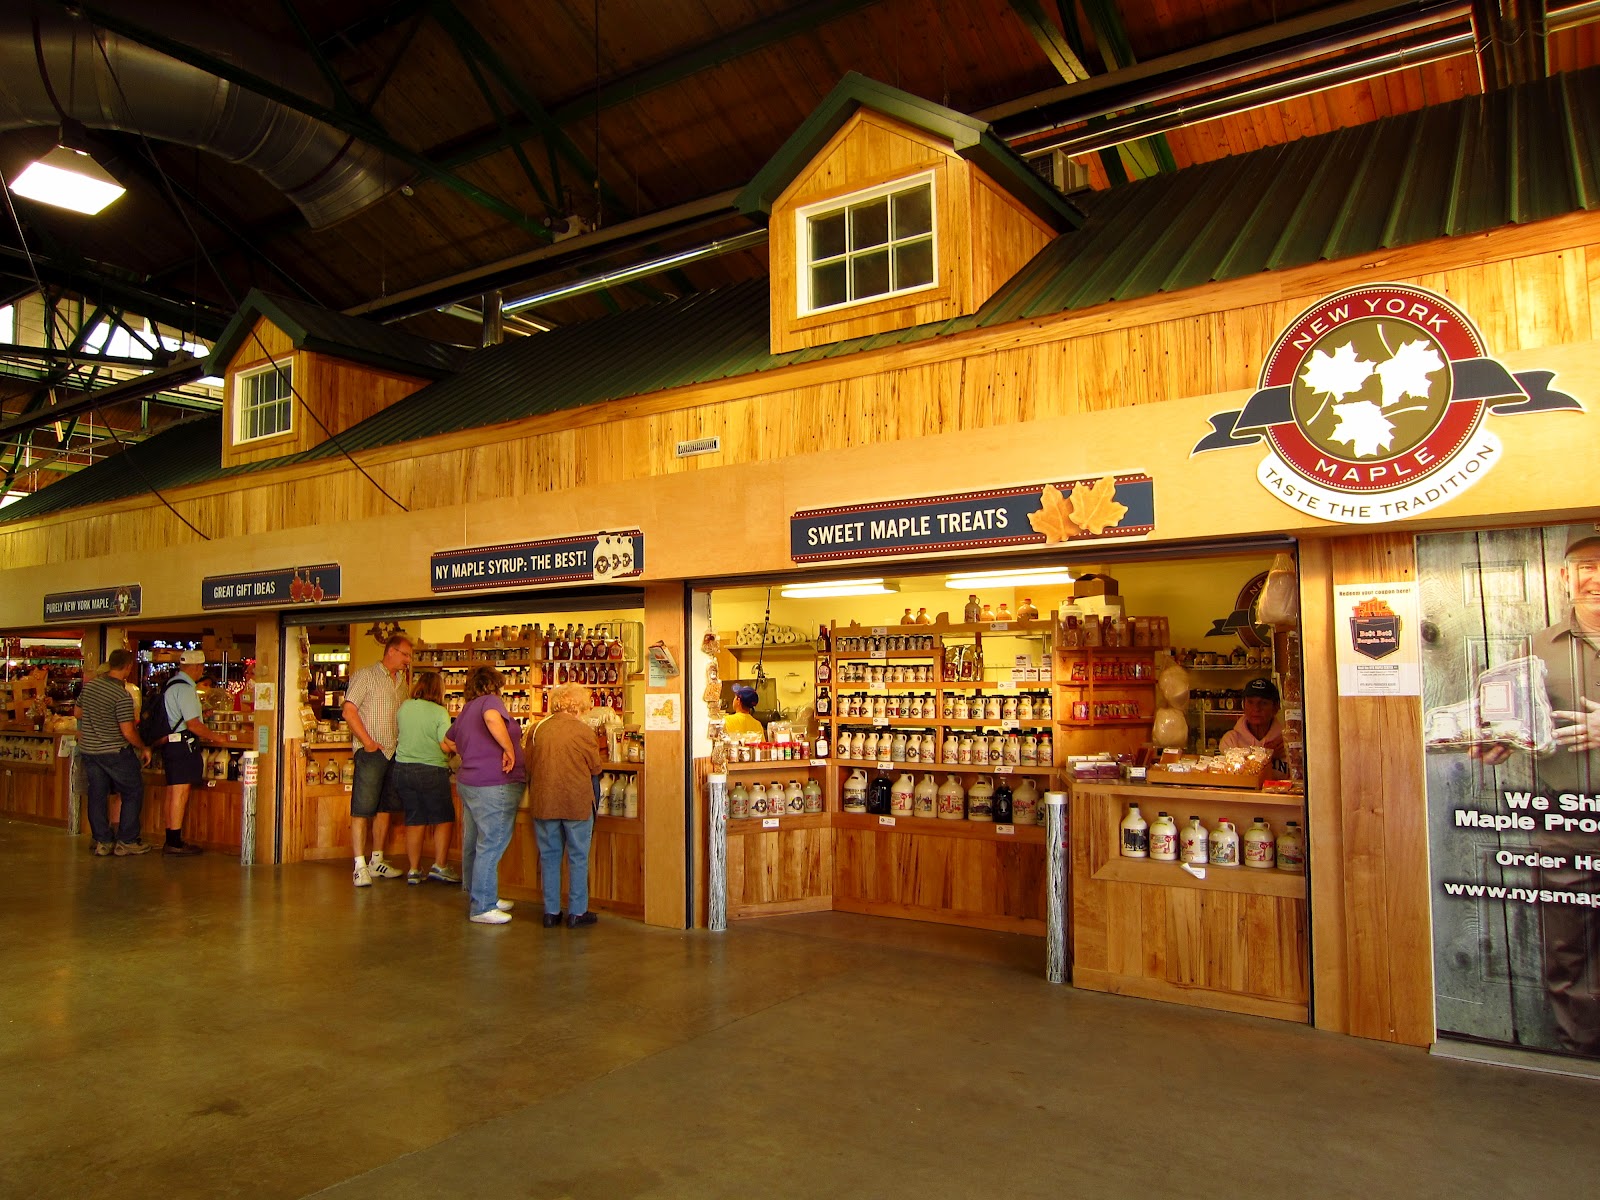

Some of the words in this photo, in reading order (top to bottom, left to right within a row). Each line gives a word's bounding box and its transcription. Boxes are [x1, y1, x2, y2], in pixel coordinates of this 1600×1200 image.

[1292, 303, 1352, 352] NEW
[1364, 297, 1449, 334] YORK
[1314, 446, 1436, 483] MAPLE
[1265, 467, 1319, 510] TASTE
[1328, 501, 1372, 519] THE
[1380, 444, 1495, 517] TRADITION
[807, 522, 865, 547] SWEET
[870, 515, 931, 541] MAPLE
[936, 507, 1009, 533] TREATS
[435, 564, 450, 580] NY
[451, 560, 485, 579] MAPLE
[488, 555, 528, 575] SYRUP:
[530, 553, 552, 570] THE
[554, 550, 588, 569] BEST!
[213, 584, 236, 599] GREAT
[236, 583, 253, 597] GIFT
[254, 581, 276, 595] IDEAS
[46, 602, 64, 614] PURELY
[63, 601, 77, 612] NEW
[77, 600, 91, 611] YORK
[91, 598, 109, 609] MAPLE
[1504, 791, 1550, 811] We
[1455, 810, 1535, 832] Maple
[1544, 813, 1600, 833] Pro
[1496, 850, 1567, 869] Order
